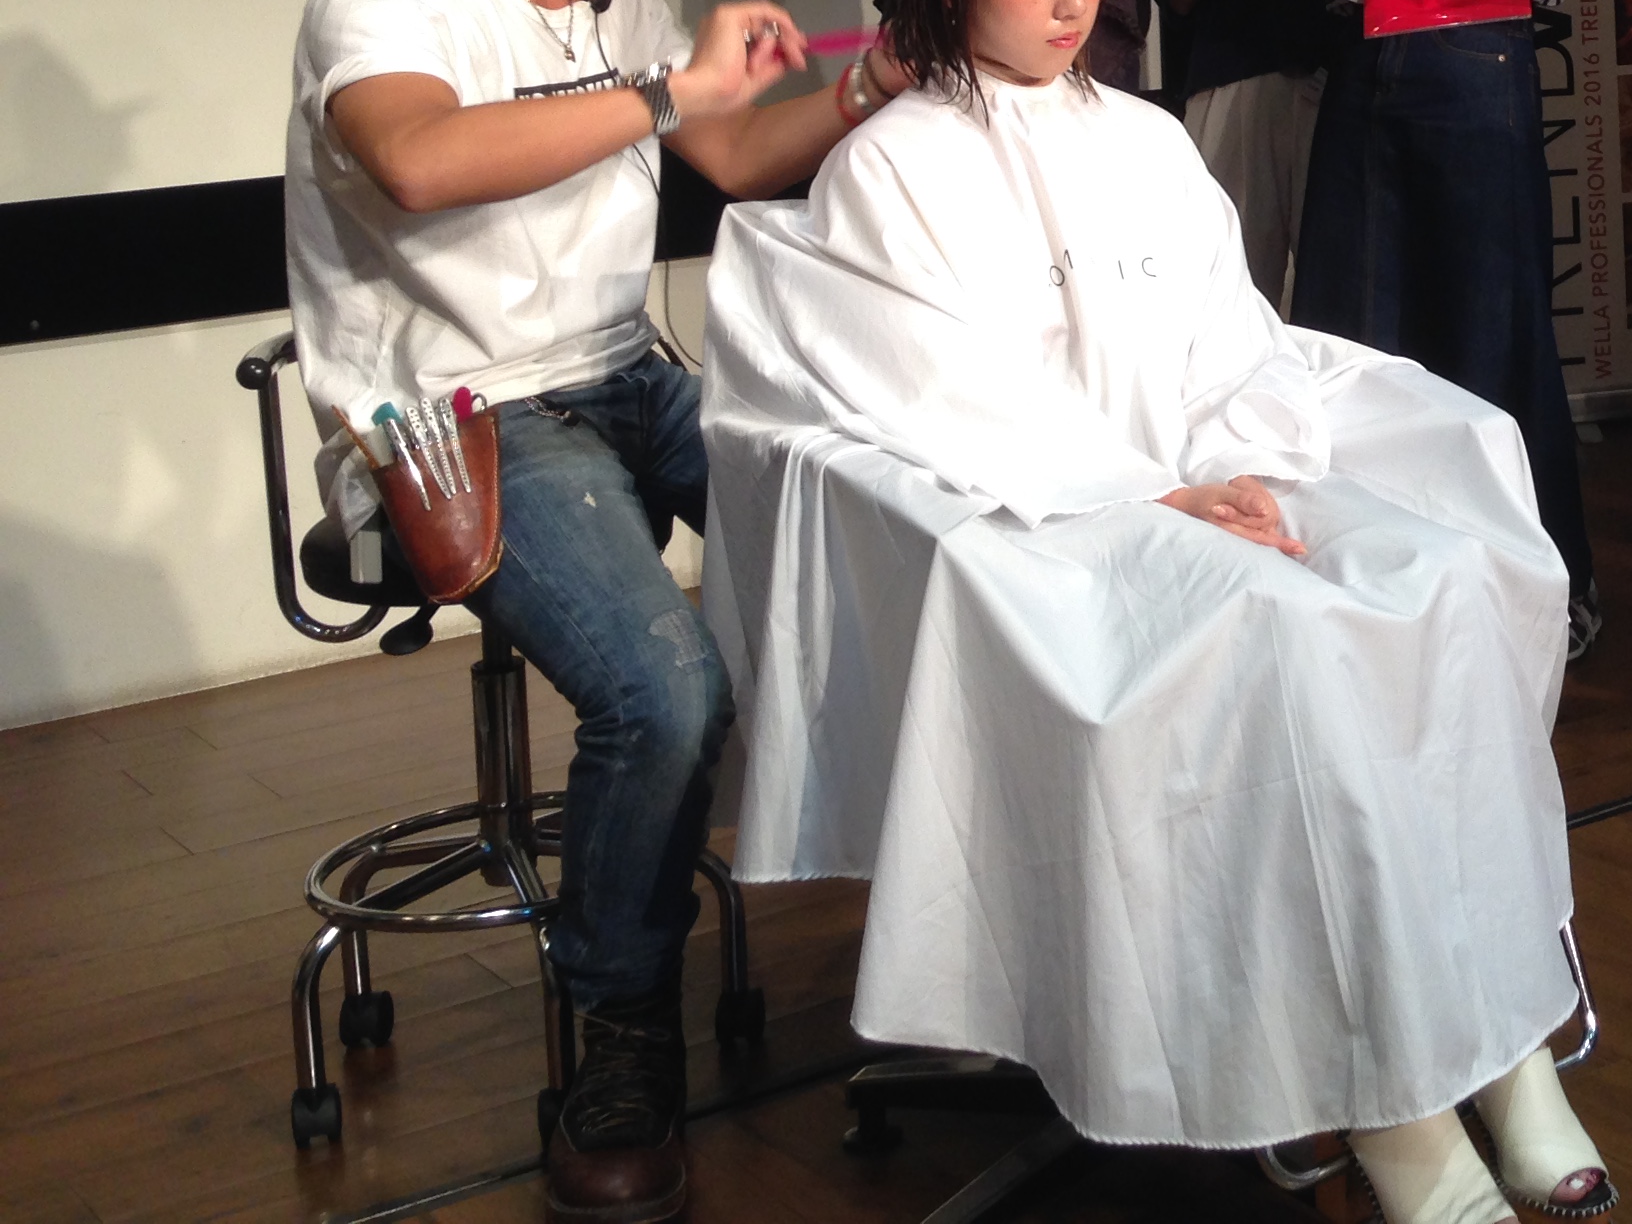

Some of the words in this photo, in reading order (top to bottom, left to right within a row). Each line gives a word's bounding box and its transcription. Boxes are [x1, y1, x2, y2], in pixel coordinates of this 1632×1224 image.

[1583, 52, 1602, 107] 2016
[1585, 114, 1609, 297] PROFESSIONALS
[1593, 305, 1613, 380] WELLA
